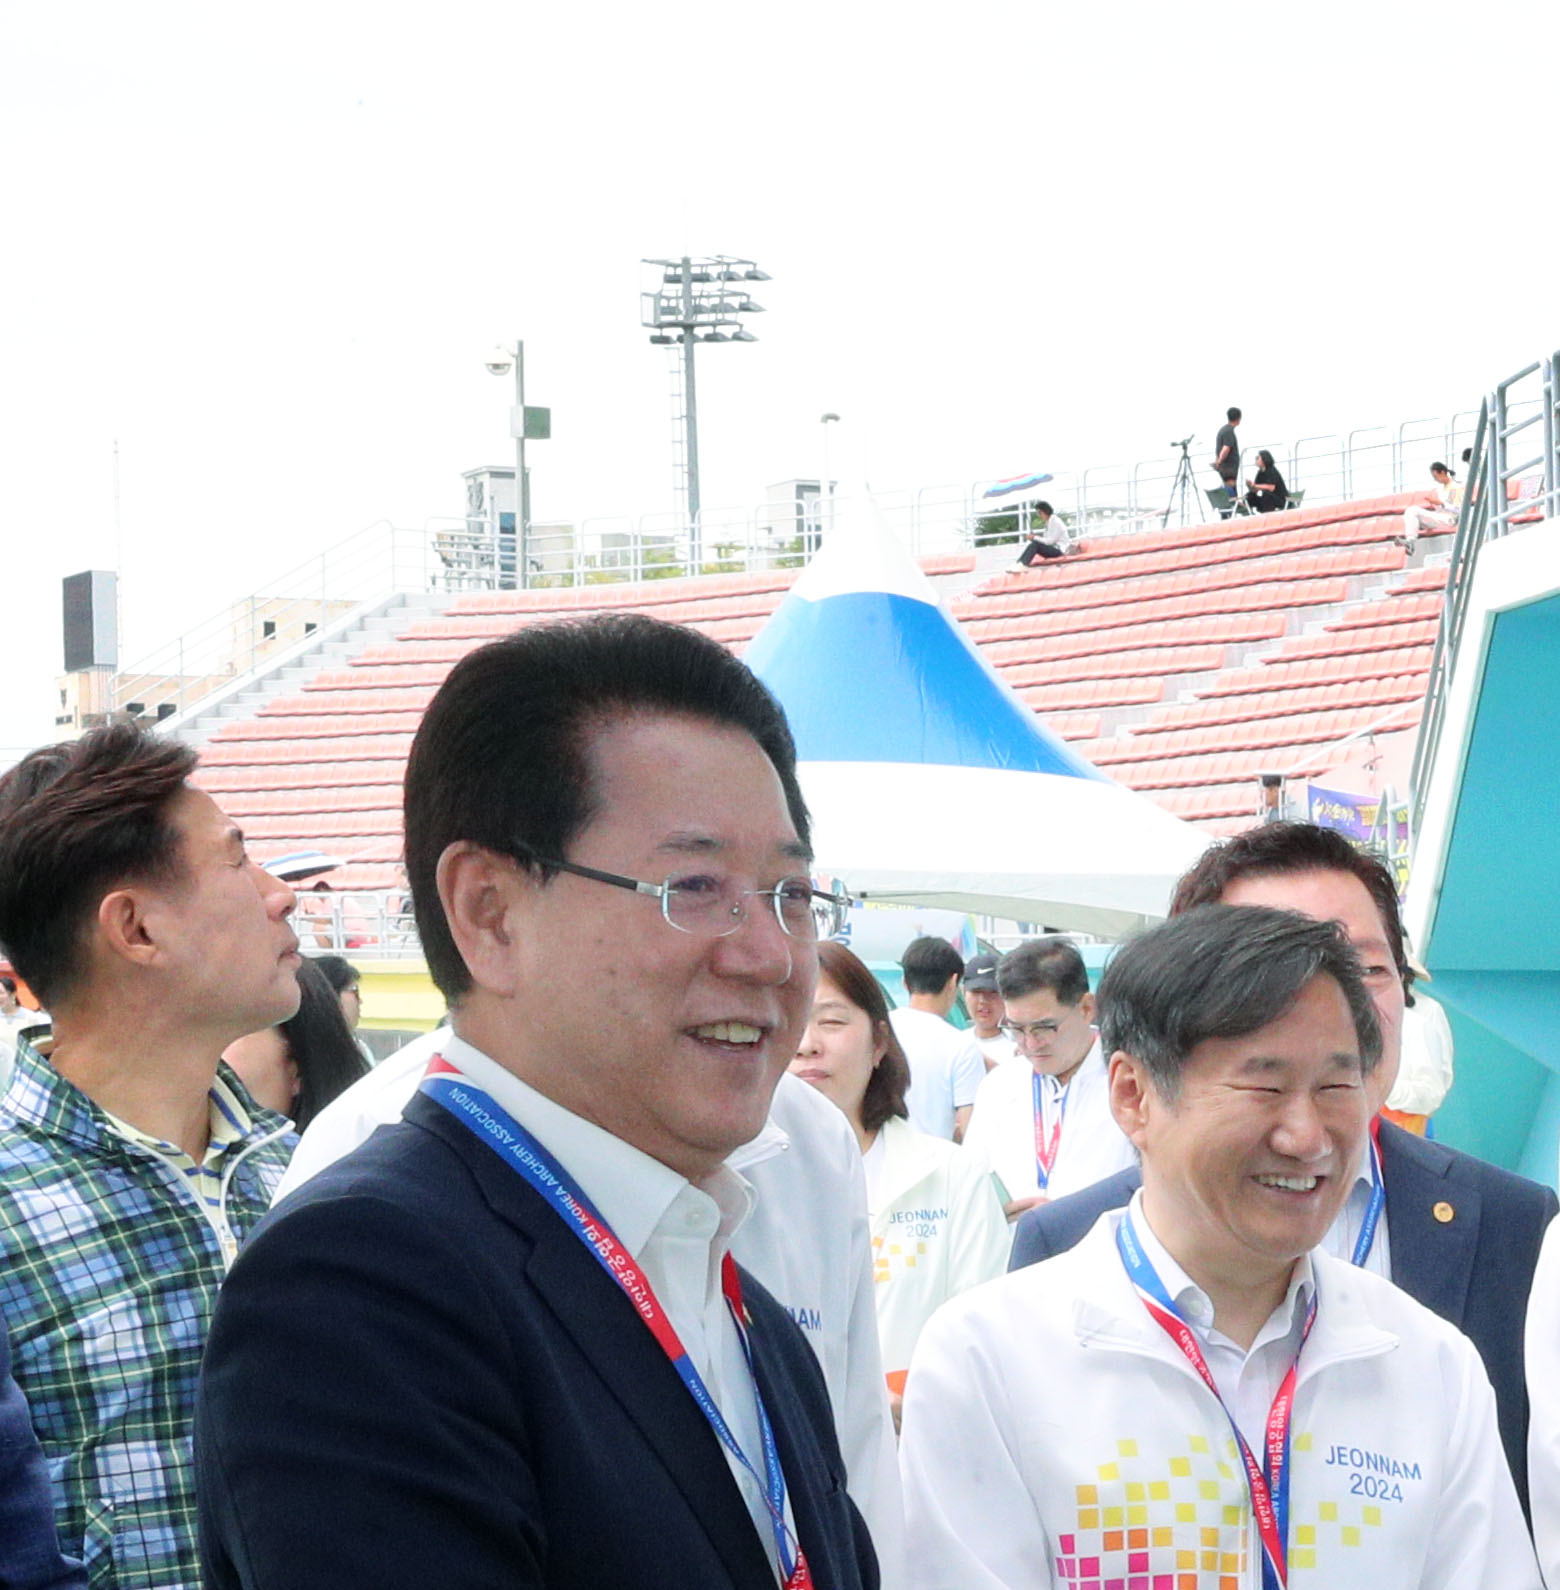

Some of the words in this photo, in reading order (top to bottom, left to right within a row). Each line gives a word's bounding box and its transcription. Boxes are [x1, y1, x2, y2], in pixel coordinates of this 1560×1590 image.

[447, 1086, 517, 1151] ASSOCIATION
[512, 1141, 562, 1189] ARCHERY
[560, 1183, 590, 1225] KOREA
[905, 1223, 938, 1238] 2024
[1325, 1445, 1422, 1480] JEONNAM
[1349, 1473, 1404, 1503] 2024
